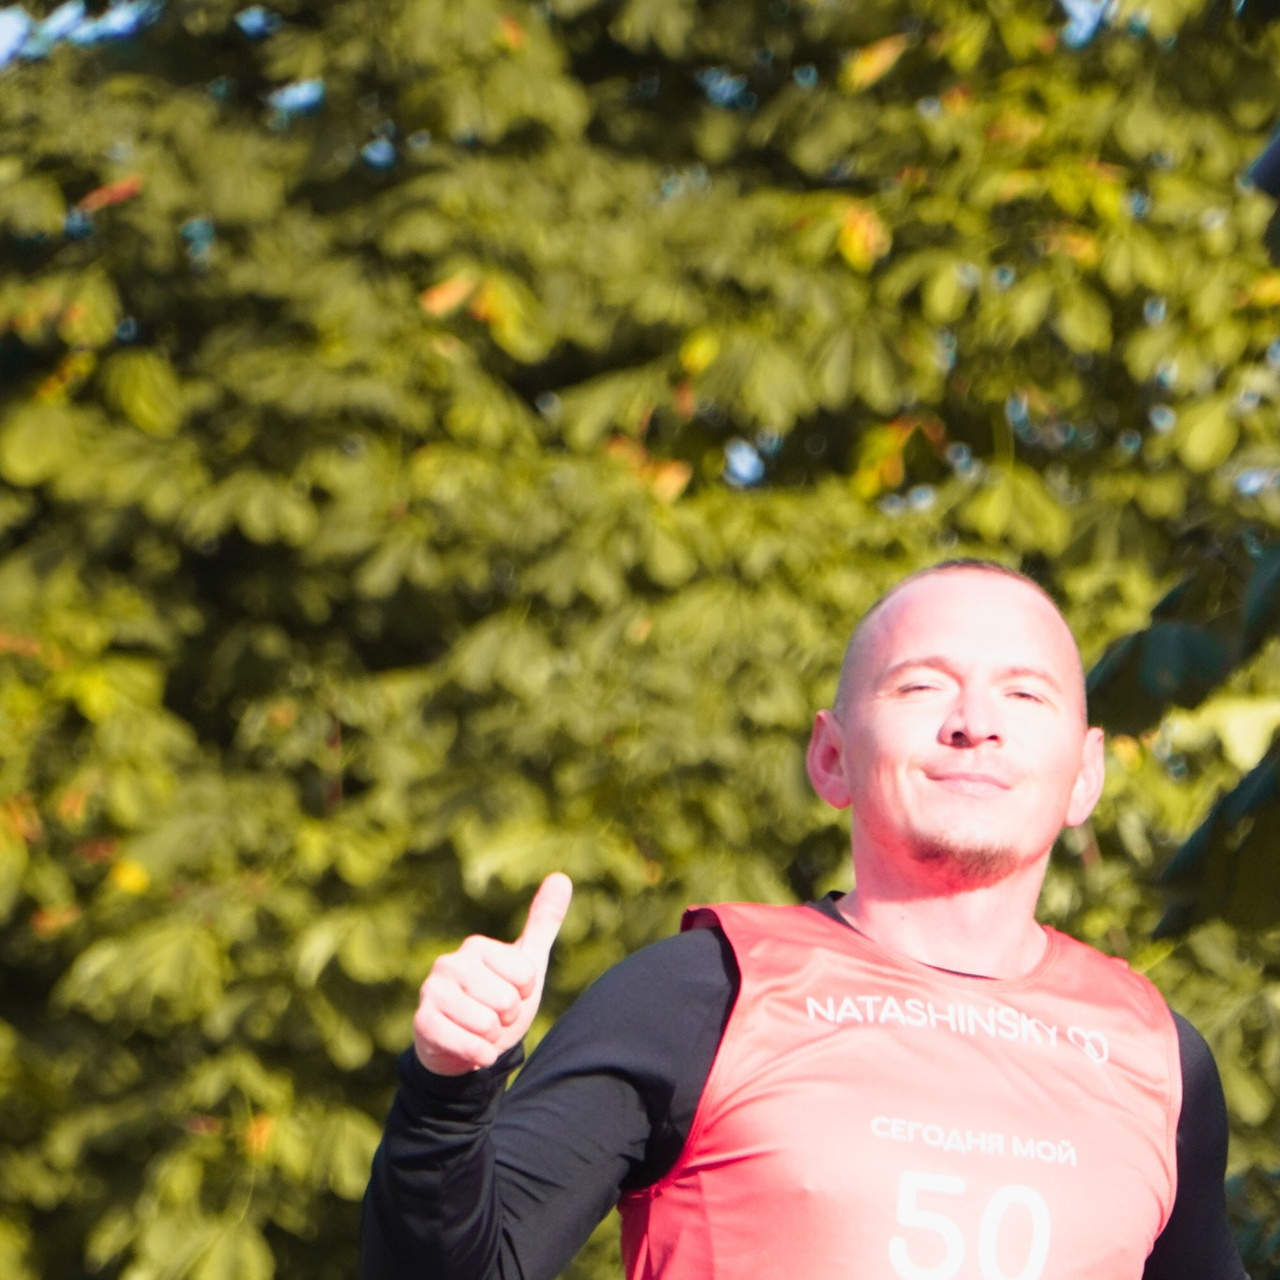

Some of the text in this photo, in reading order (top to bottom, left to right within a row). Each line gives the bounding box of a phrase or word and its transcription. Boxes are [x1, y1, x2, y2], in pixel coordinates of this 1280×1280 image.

[805, 995, 1058, 1050] NATASHINSKY
[870, 1115, 1078, 1168] СЕГОДНЯ МОЙ
